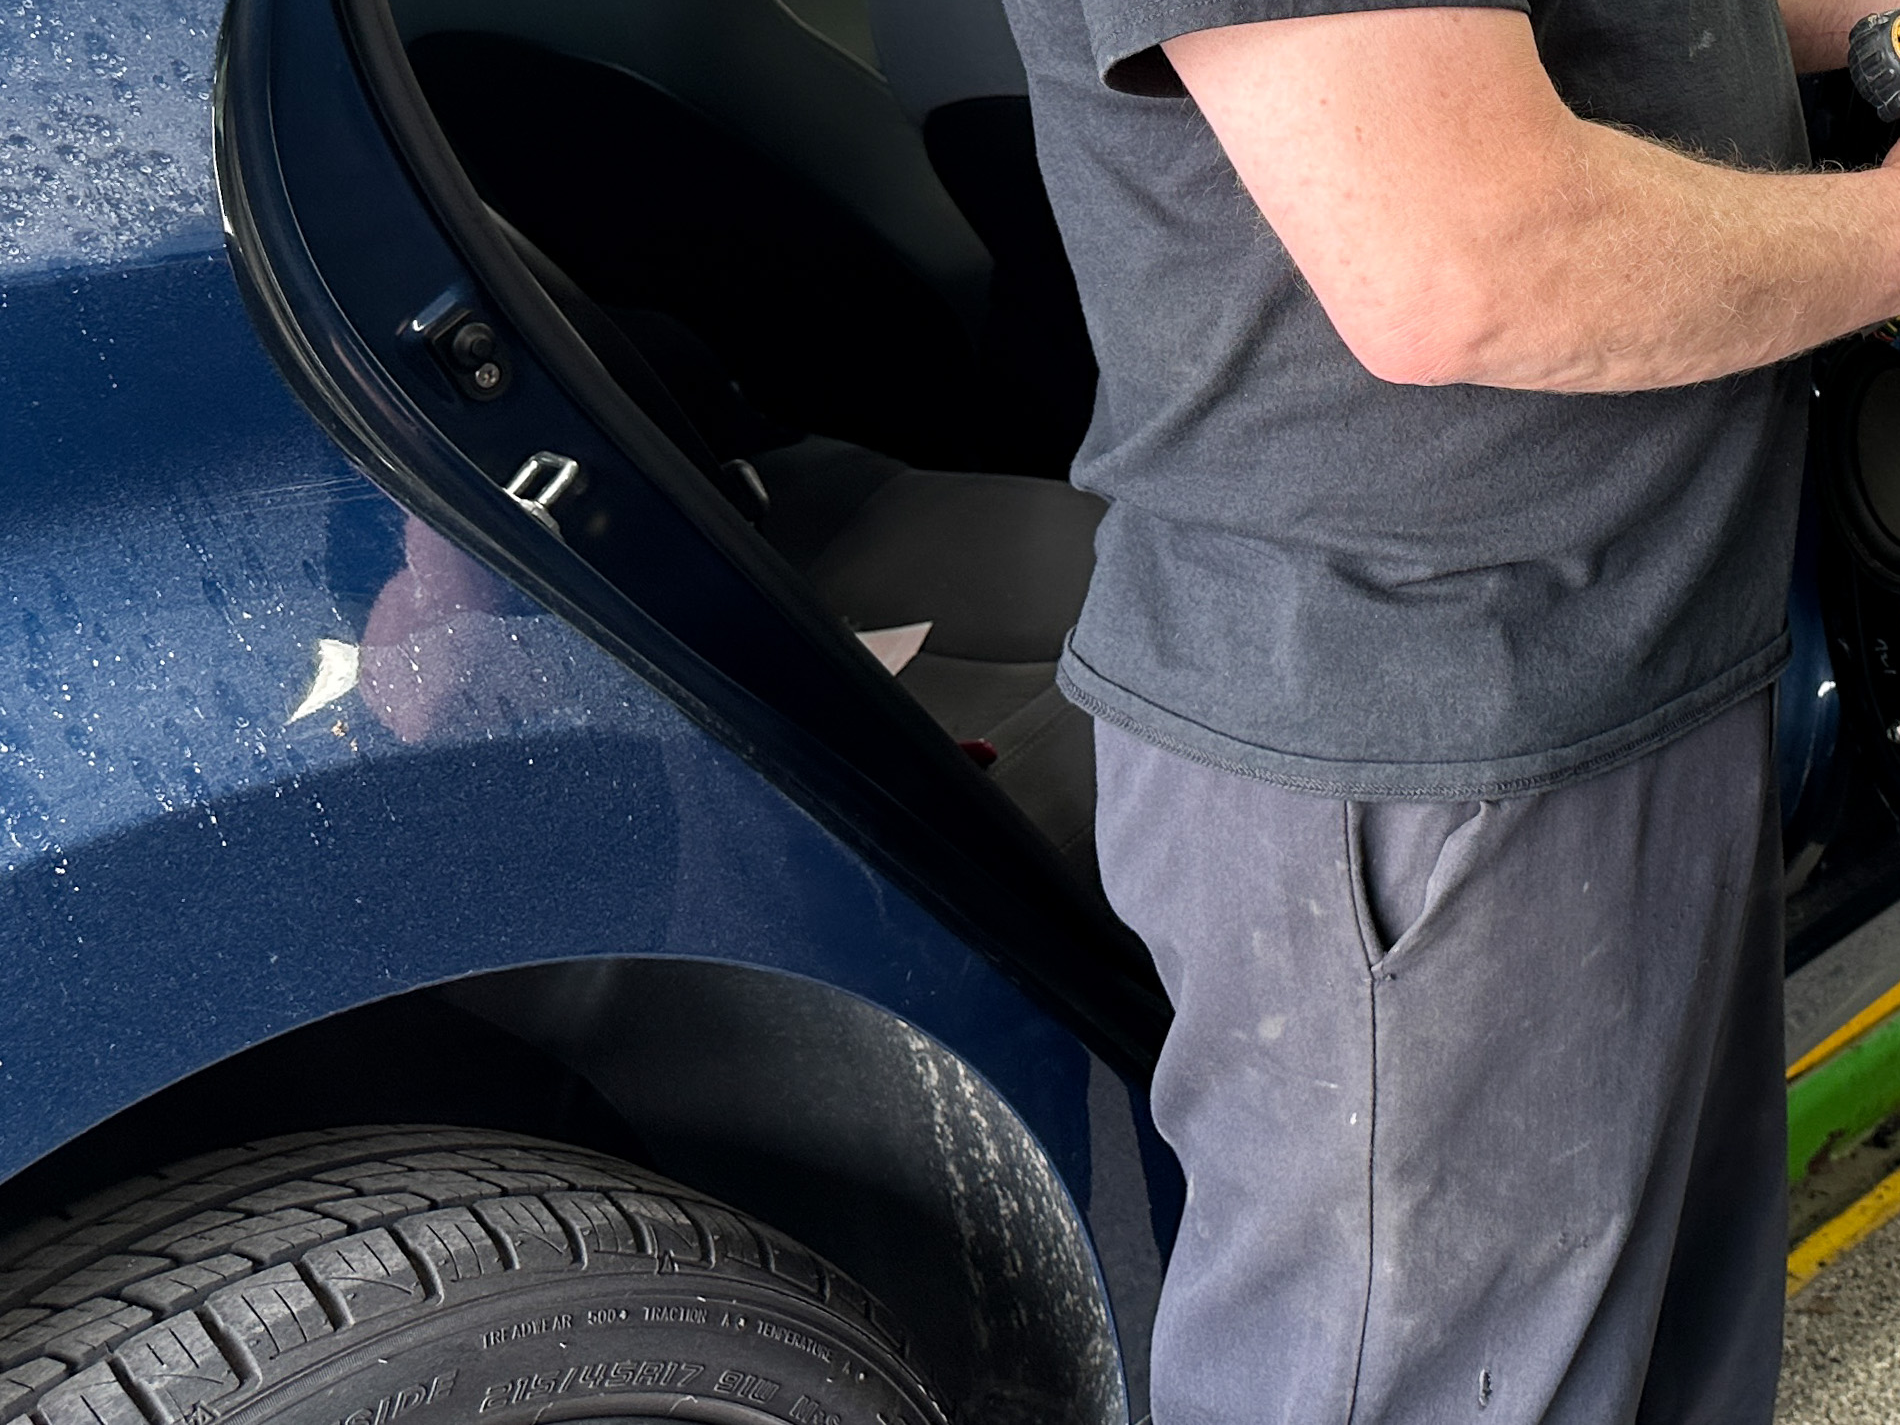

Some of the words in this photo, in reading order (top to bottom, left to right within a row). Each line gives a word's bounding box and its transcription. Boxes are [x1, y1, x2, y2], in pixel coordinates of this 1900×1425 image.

[480, 1313, 573, 1349] TREADWEAR
[642, 1307, 708, 1324] TRACTION
[757, 1320, 833, 1364] TEMPERATURE
[479, 1359, 705, 1414] 215/45R17
